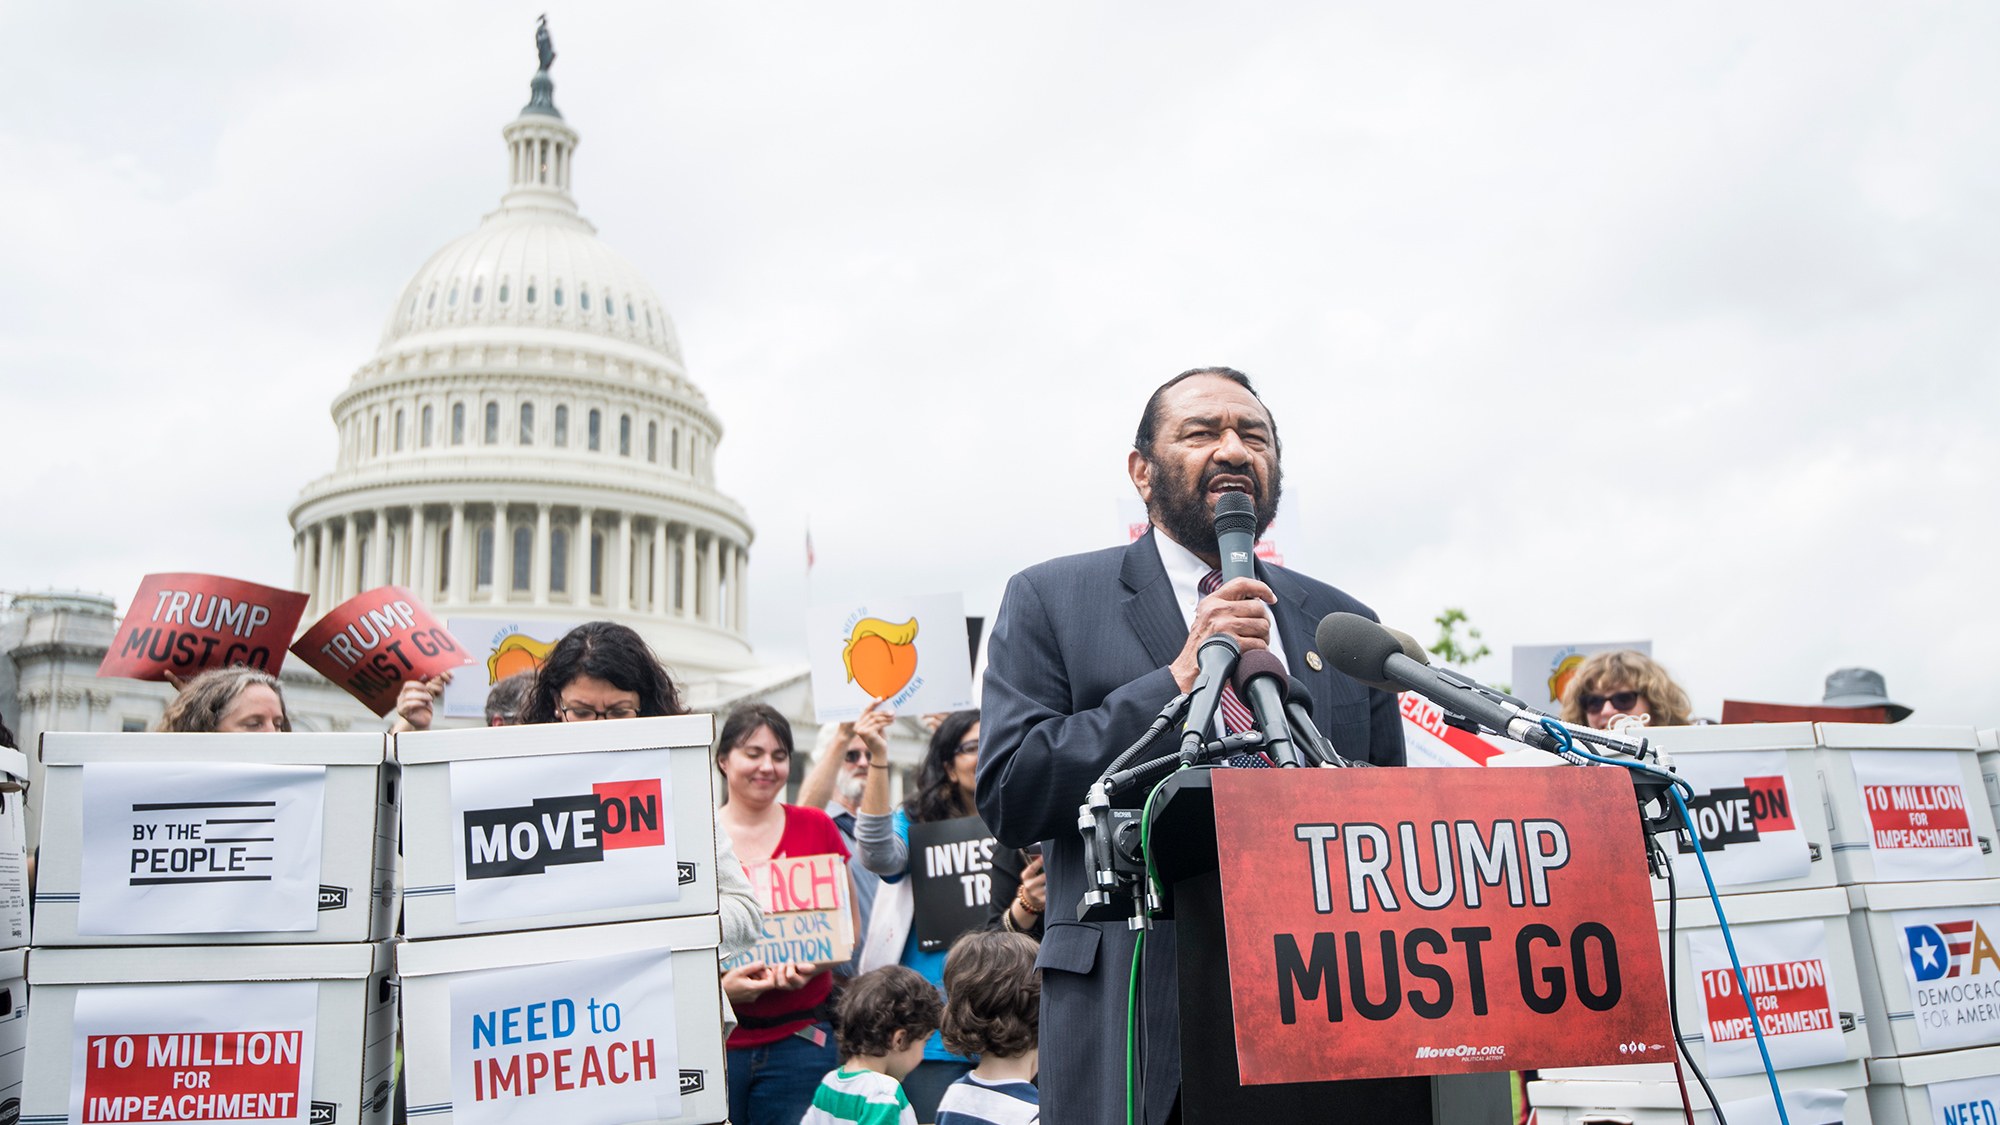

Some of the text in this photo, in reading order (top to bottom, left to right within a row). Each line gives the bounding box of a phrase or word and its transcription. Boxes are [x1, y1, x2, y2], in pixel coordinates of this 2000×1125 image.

[152, 590, 271, 638] TRUMP
[121, 627, 220, 671] MUST
[320, 599, 417, 671] TRUMP
[347, 627, 457, 702] MUST GO
[892, 676, 925, 709] IMPEACH
[1865, 786, 1964, 811] 10 MILLION
[133, 824, 202, 840] BY THE
[1909, 812, 1928, 826] FOR
[1876, 829, 1970, 848] IMPEACHMENT
[131, 847, 246, 873] PEOPLE
[925, 837, 998, 878] INVES
[1294, 818, 1570, 914] TRUMP
[961, 873, 991, 907] TR
[759, 913, 832, 939] CT OUR
[1274, 922, 1622, 1025] MUST GO
[1704, 960, 1824, 999] 10 MILLION
[1755, 995, 1779, 1012] FOR
[1918, 980, 2000, 1007] DEMOCRAC
[472, 998, 620, 1050] NEED to
[1712, 1009, 1829, 1042] IMPEACHMENT
[1922, 1002, 2000, 1029] FOR AMERI
[92, 1032, 299, 1069] 10 MILLION
[1415, 1045, 1505, 1059] MoveOn.ORG
[172, 1071, 210, 1088] FOR
[473, 1038, 657, 1102] IMPEACH
[88, 1092, 295, 1122] IMPEACHMENT
